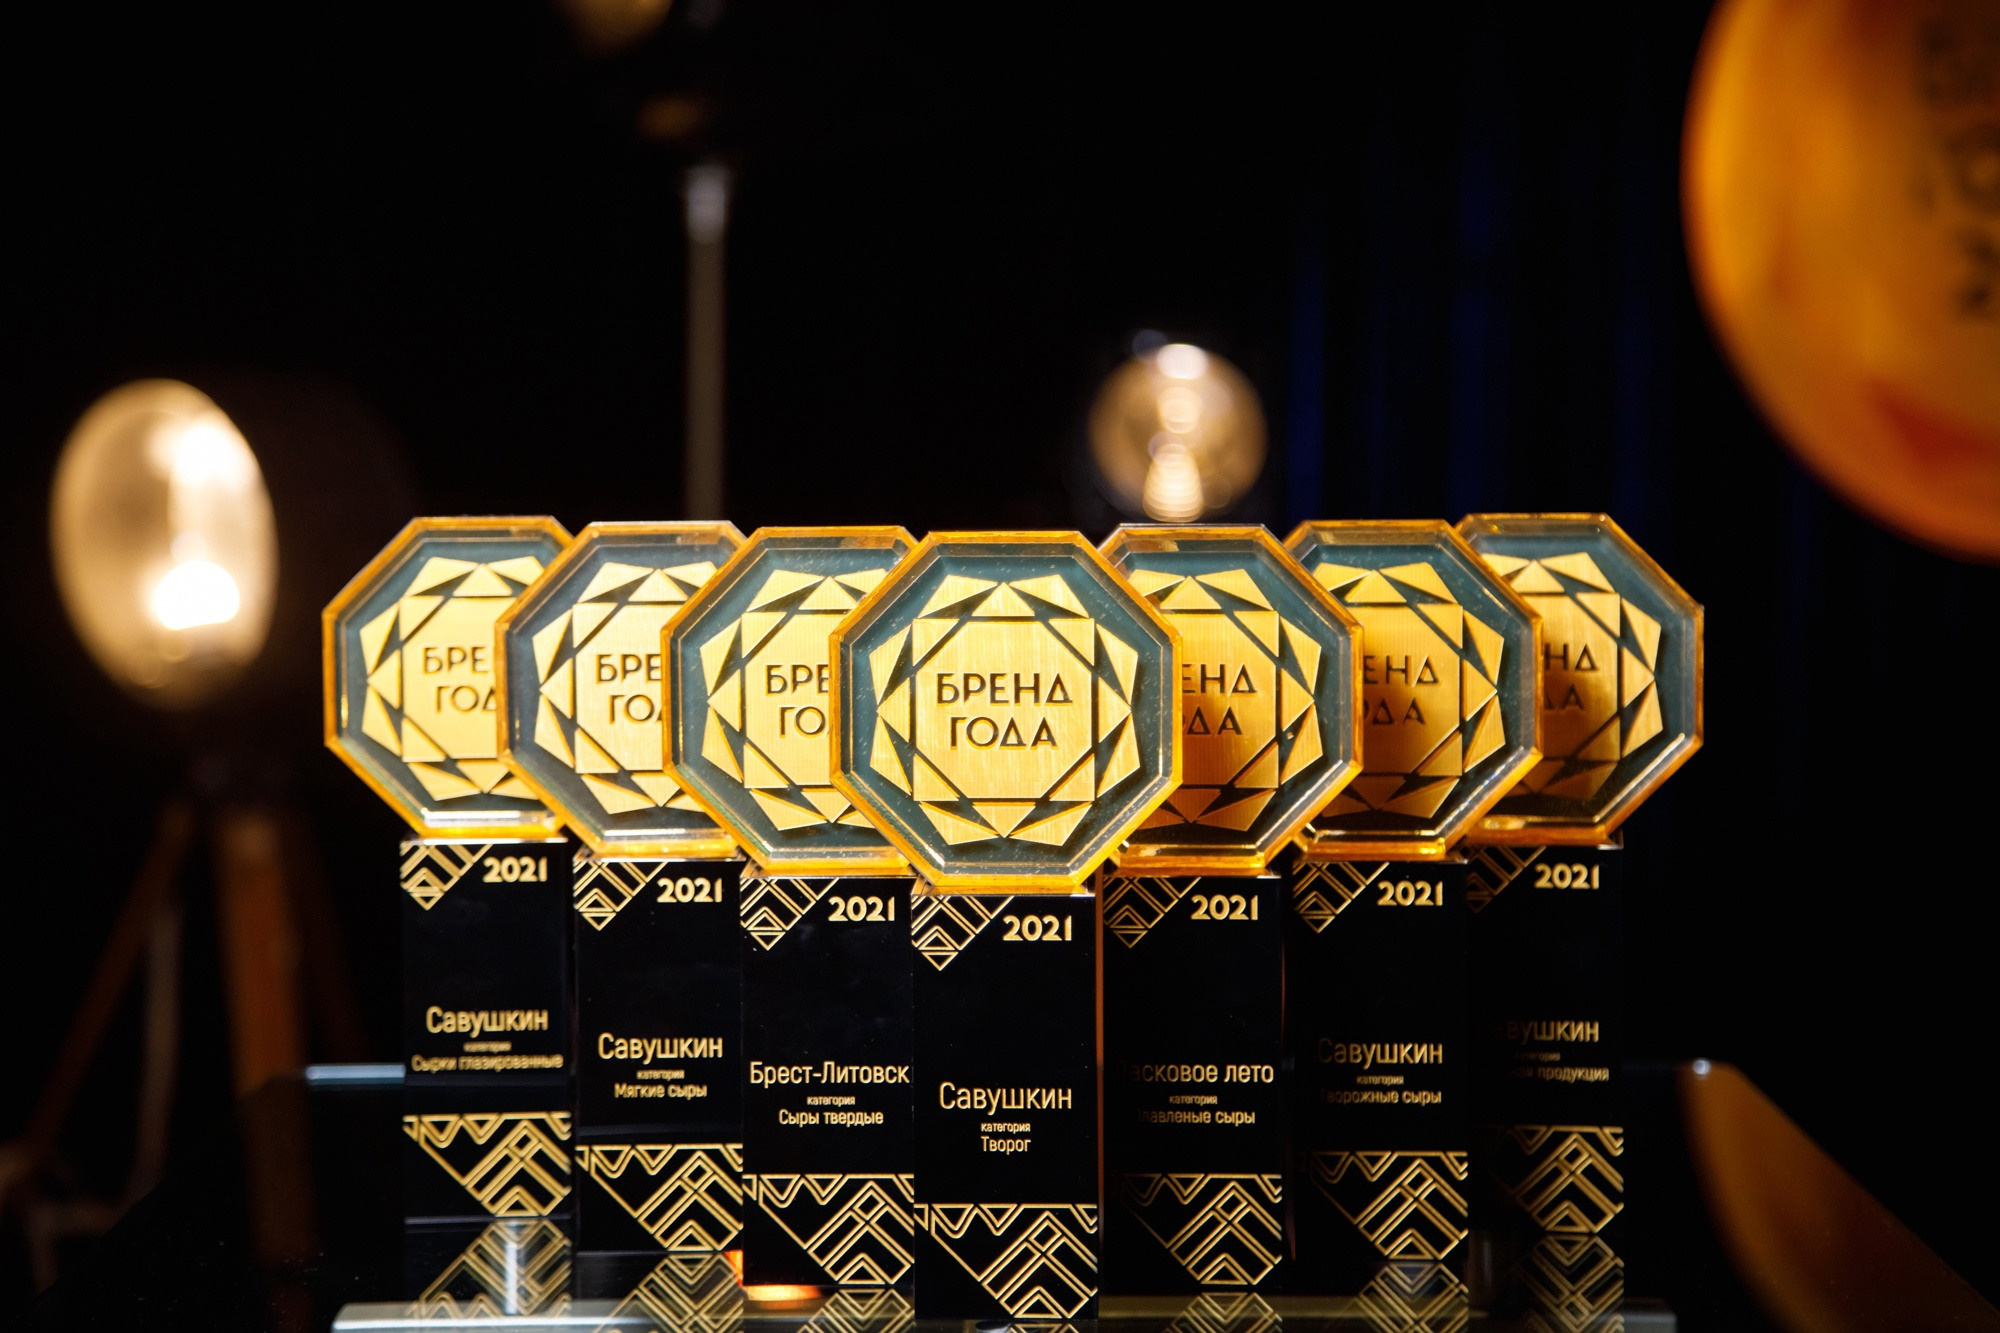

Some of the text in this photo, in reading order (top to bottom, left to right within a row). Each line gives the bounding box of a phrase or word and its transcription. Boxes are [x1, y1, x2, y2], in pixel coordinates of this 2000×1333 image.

[423, 646, 488, 675] БРЕ
[596, 654, 661, 682] БРЕ
[1364, 655, 1440, 684] ЕНД
[766, 664, 829, 694] БРЕ
[937, 673, 1073, 705] БРЕНД
[1182, 663, 1257, 694] ЕНД
[435, 686, 496, 713] ГОД
[609, 694, 661, 724] ГО
[1364, 698, 1425, 725] ДА
[779, 706, 829, 738] ГО
[950, 716, 1057, 749] ГОДА
[1183, 706, 1243, 736] ДА
[483, 856, 547, 882] 2021
[1534, 863, 1599, 889] 2021
[657, 877, 722, 903] 2021
[1376, 880, 1443, 906] 2021
[828, 895, 895, 921] 2021
[1190, 894, 1258, 920] 2021
[1002, 915, 1072, 941] 2021
[427, 1006, 548, 1038] Савушкин
[599, 1033, 722, 1065] Савушкин
[1318, 1037, 1443, 1070] Савушкин
[412, 1054, 563, 1072] Сырки глазированные
[750, 1061, 909, 1088] Брест-Литовск
[1117, 1060, 1274, 1083] асковое лето
[615, 1083, 707, 1100] Мягкие сыры
[807, 1096, 855, 1107] категория
[940, 1082, 1071, 1115] Савушкин
[1321, 1089, 1441, 1106] ворожные сыры
[779, 1109, 883, 1127] Сыры твердые
[981, 1123, 1030, 1134] категория
[1215, 1111, 1255, 1127] сыры
[981, 1136, 1031, 1155] Творог
